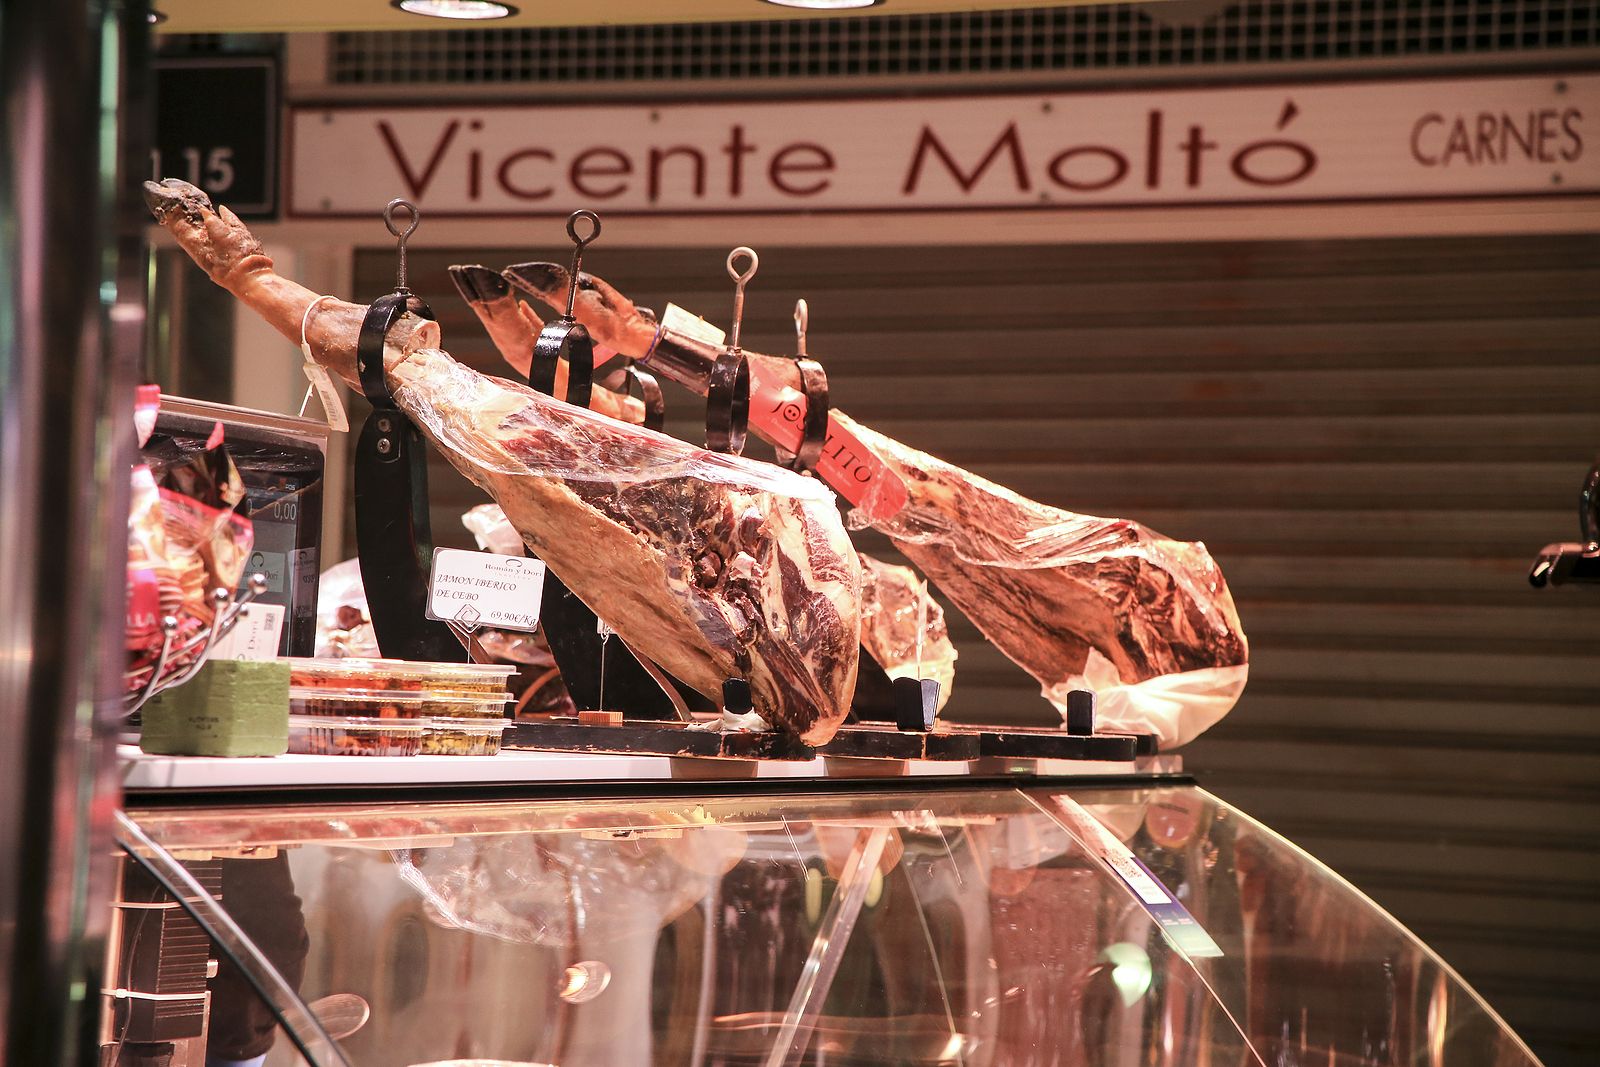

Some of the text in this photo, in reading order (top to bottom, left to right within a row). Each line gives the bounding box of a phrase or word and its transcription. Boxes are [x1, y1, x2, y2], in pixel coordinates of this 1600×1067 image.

[375, 98, 1319, 201] Vicente Moltó
[1409, 108, 1585, 168] CARNES
[183, 147, 235, 192] 15
[770, 401, 873, 483] JOLITO
[273, 502, 297, 521] 0,00
[435, 589, 480, 601] DE CEBO
[436, 574, 517, 591] JAMON IBERICO
